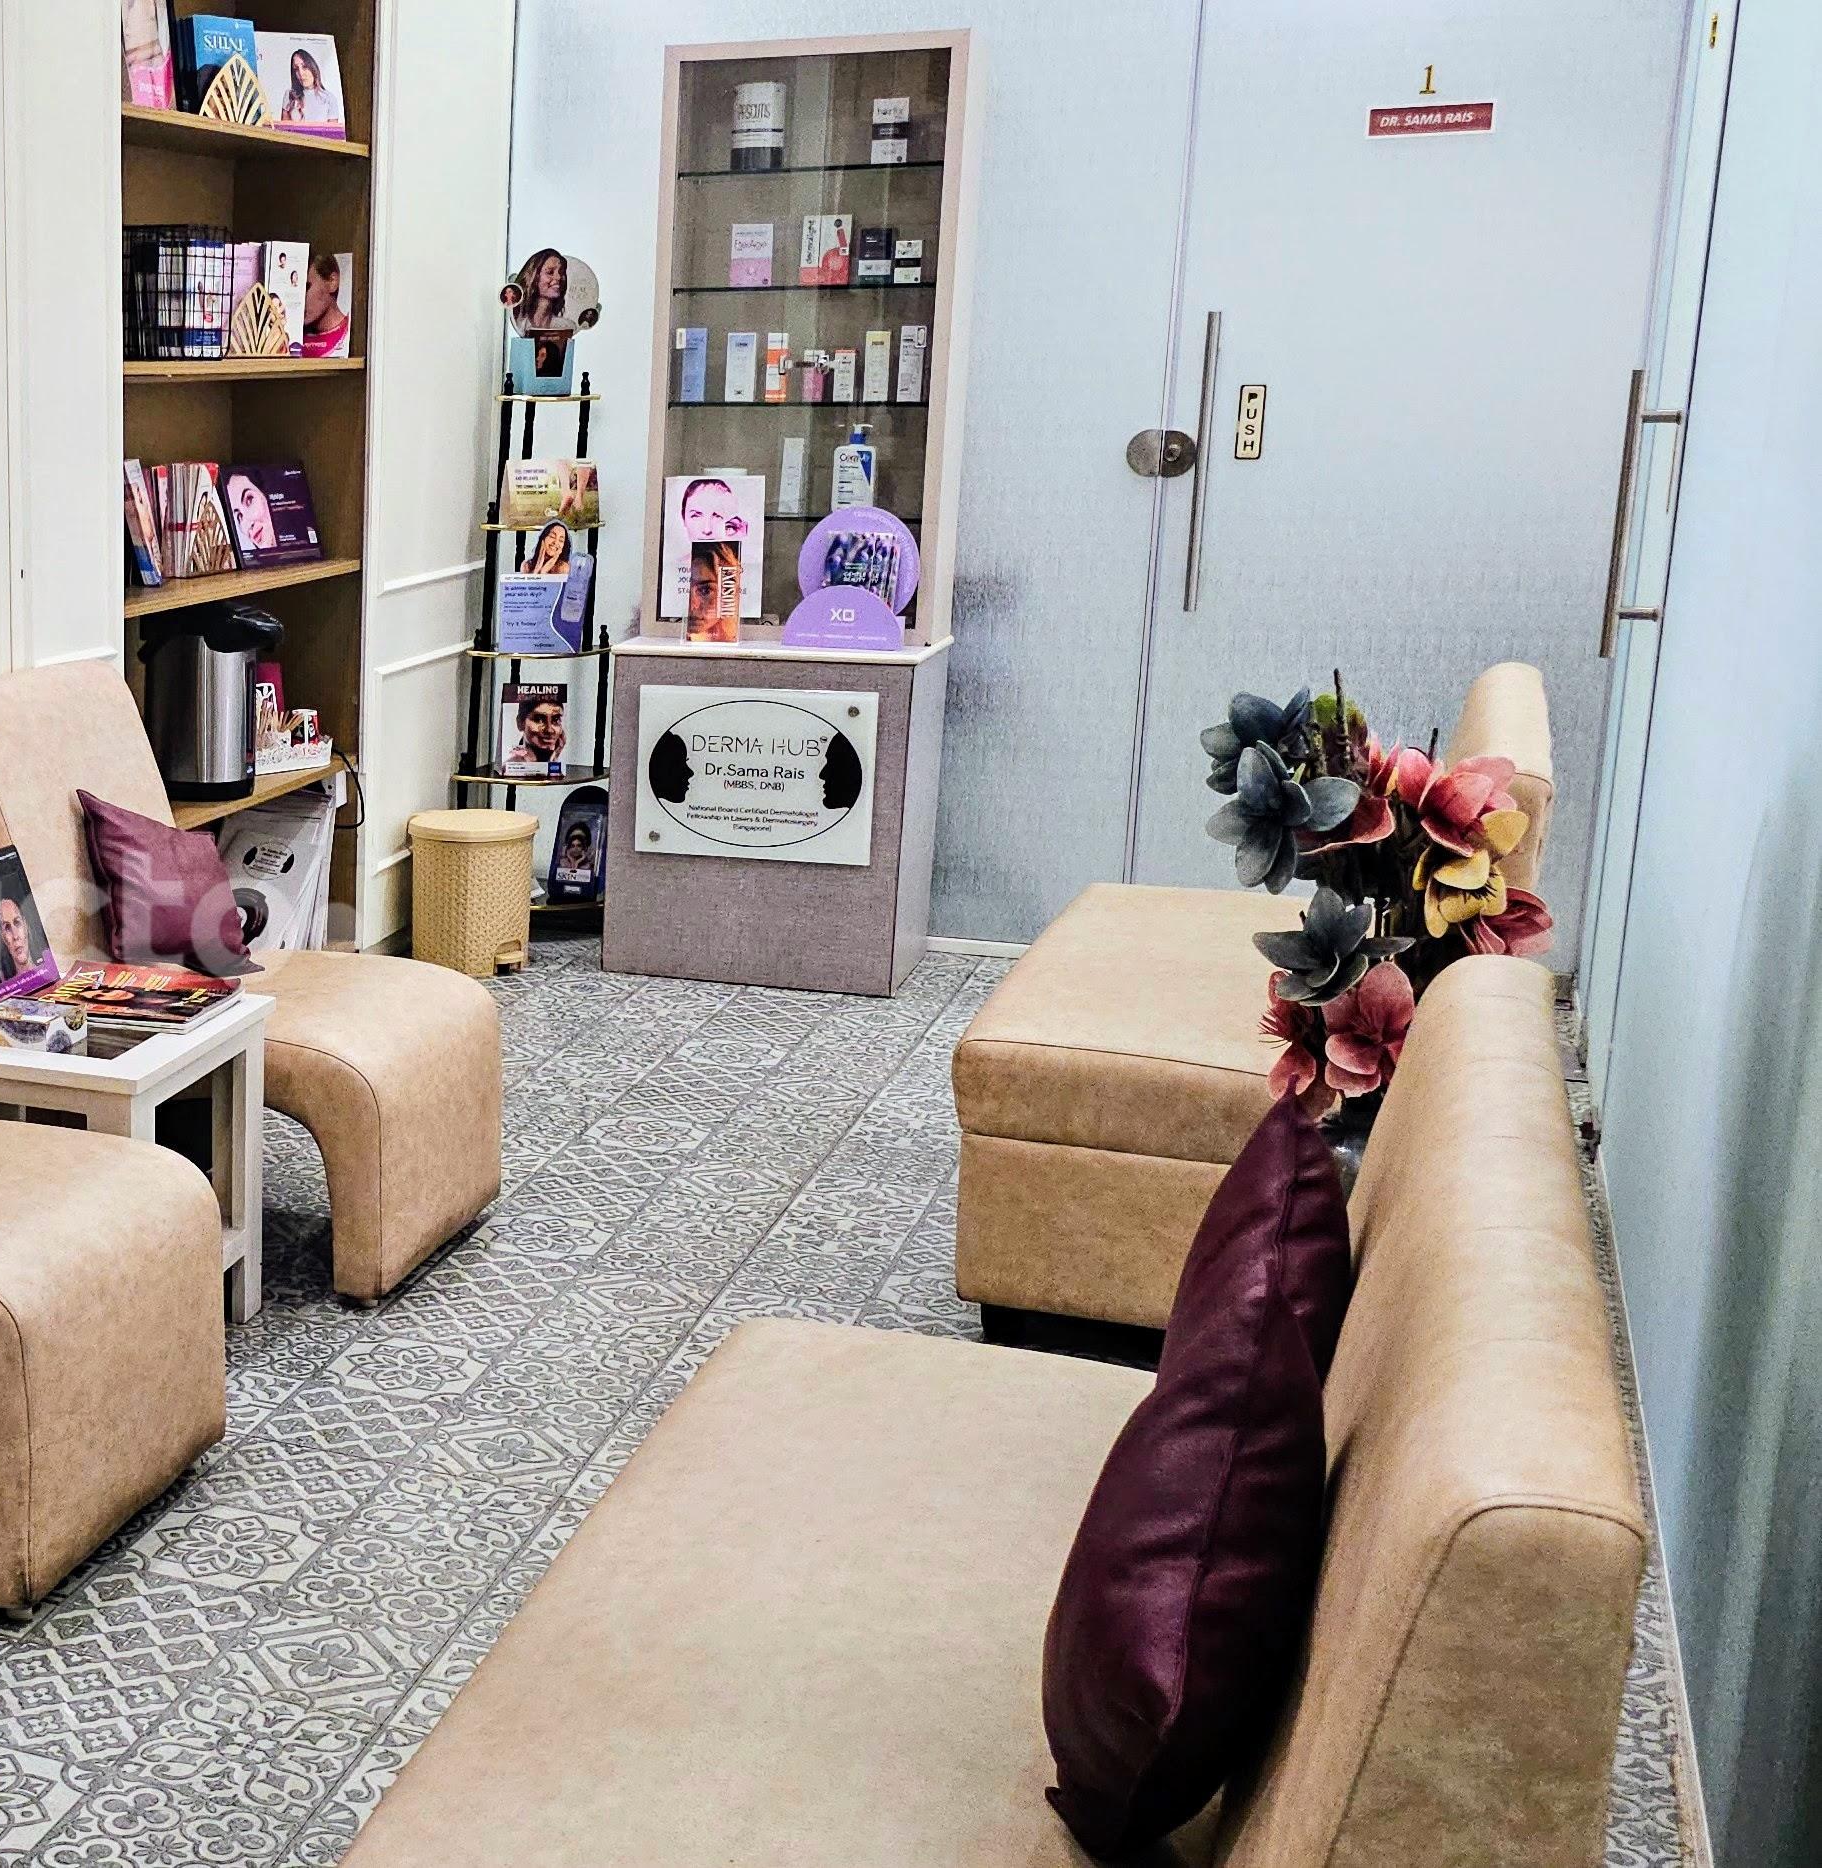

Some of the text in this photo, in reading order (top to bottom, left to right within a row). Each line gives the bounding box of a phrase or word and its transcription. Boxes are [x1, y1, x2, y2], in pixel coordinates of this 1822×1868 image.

[1419, 64, 1436, 94] 1
[1380, 111, 1474, 127] DR. SAMA RAIS
[1242, 392, 1258, 451] PUSH
[517, 685, 559, 695] HEALING
[692, 735, 821, 756] DERMA HUB
[773, 766, 805, 779] Rais
[759, 781, 785, 792] DNB)
[688, 804, 716, 812] National
